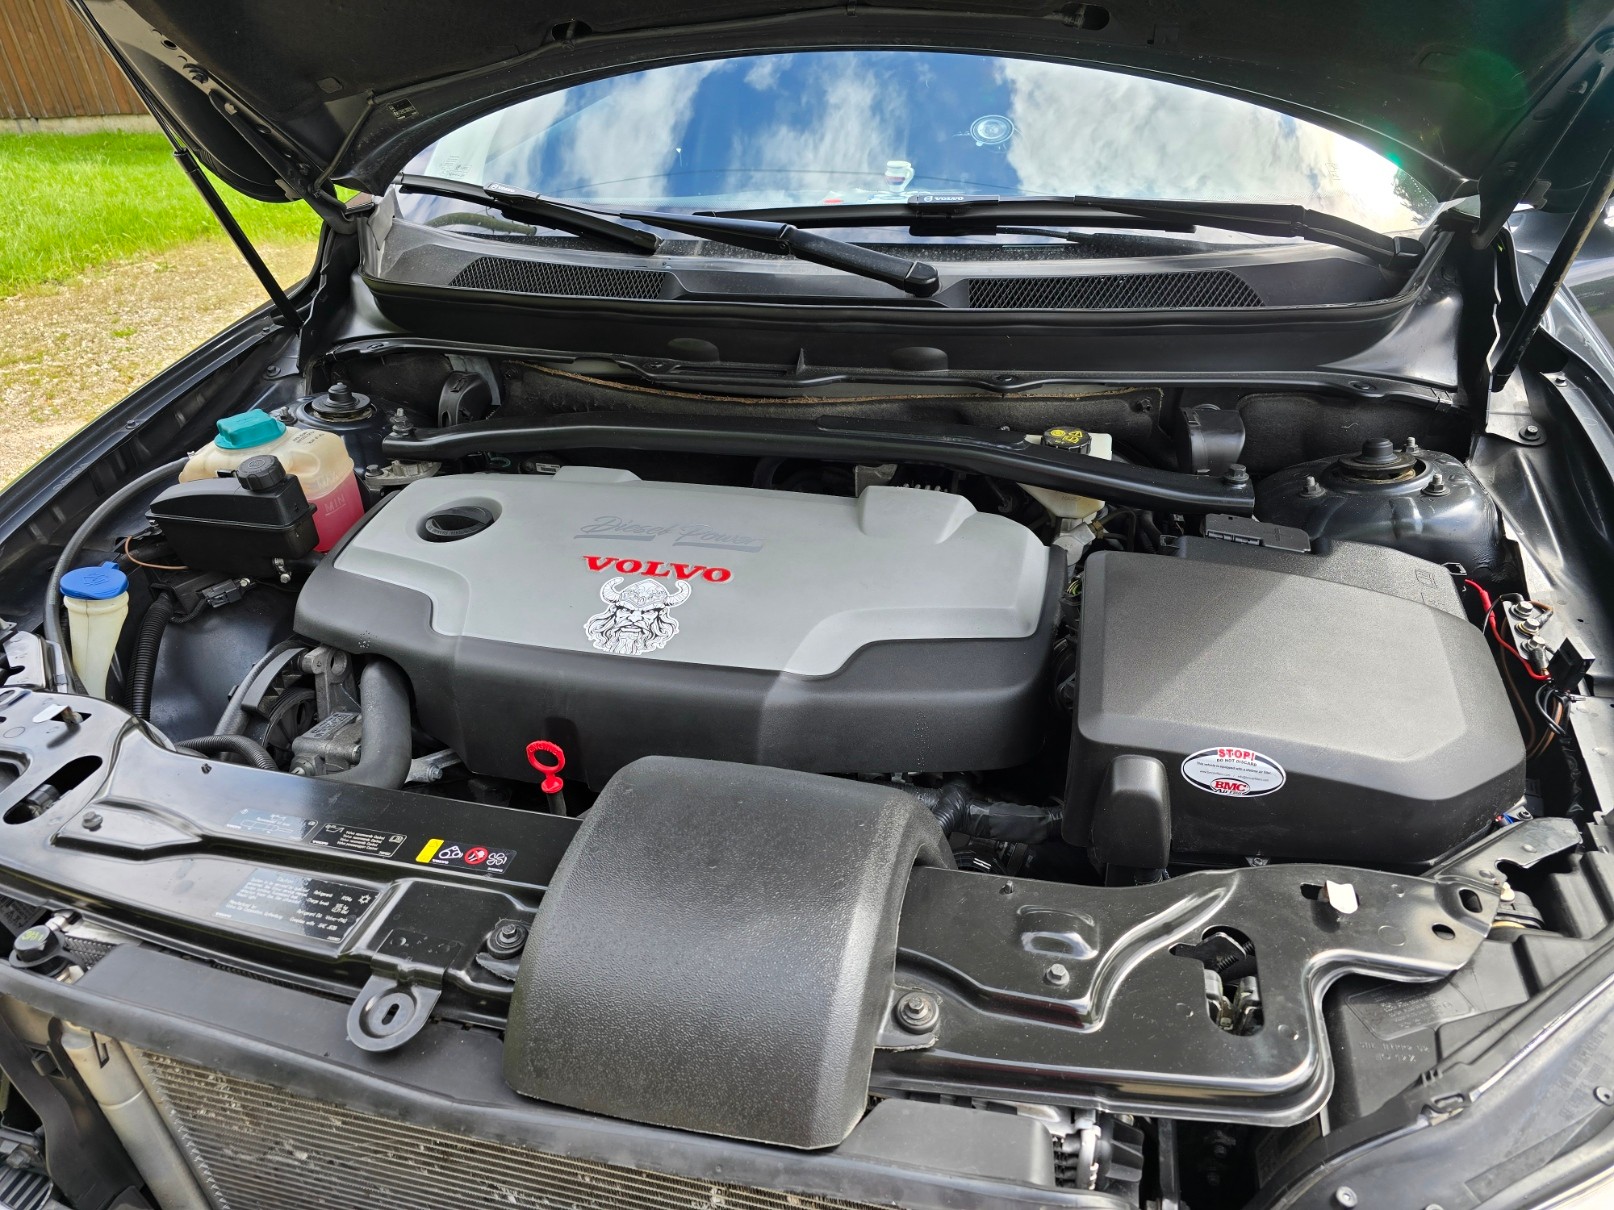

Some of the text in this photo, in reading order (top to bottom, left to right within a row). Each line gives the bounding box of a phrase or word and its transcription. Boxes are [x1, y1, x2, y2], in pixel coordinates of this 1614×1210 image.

[324, 494, 346, 513] MIN
[580, 515, 766, 545] Diesel Power
[583, 555, 732, 584] VOLVO
[1218, 748, 1255, 760] STOP!
[1215, 781, 1247, 792] BMC
